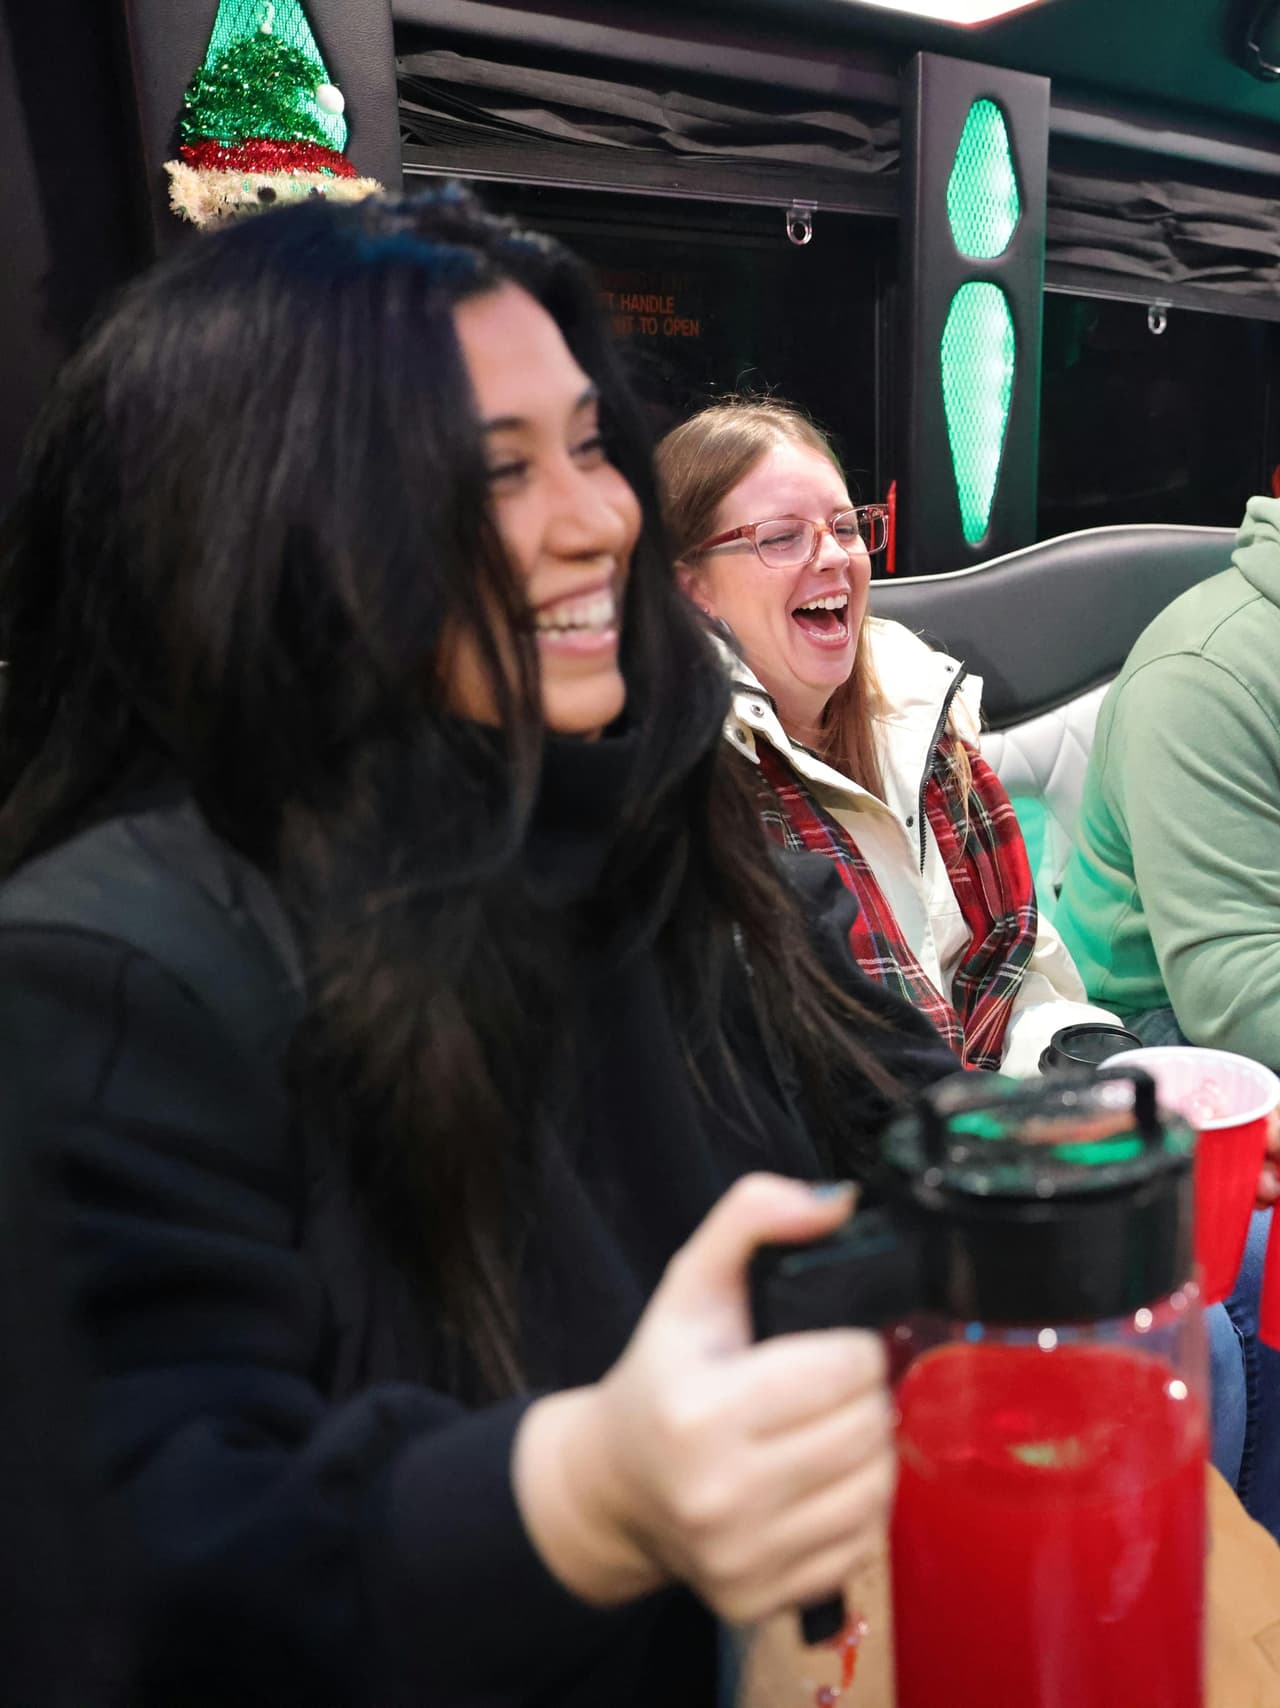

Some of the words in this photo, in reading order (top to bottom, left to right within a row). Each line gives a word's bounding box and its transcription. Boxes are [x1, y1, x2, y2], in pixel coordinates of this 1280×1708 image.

[620, 292, 675, 315] HANDLE
[638, 316, 659, 337] TO
[663, 317, 701, 338] OPEN
